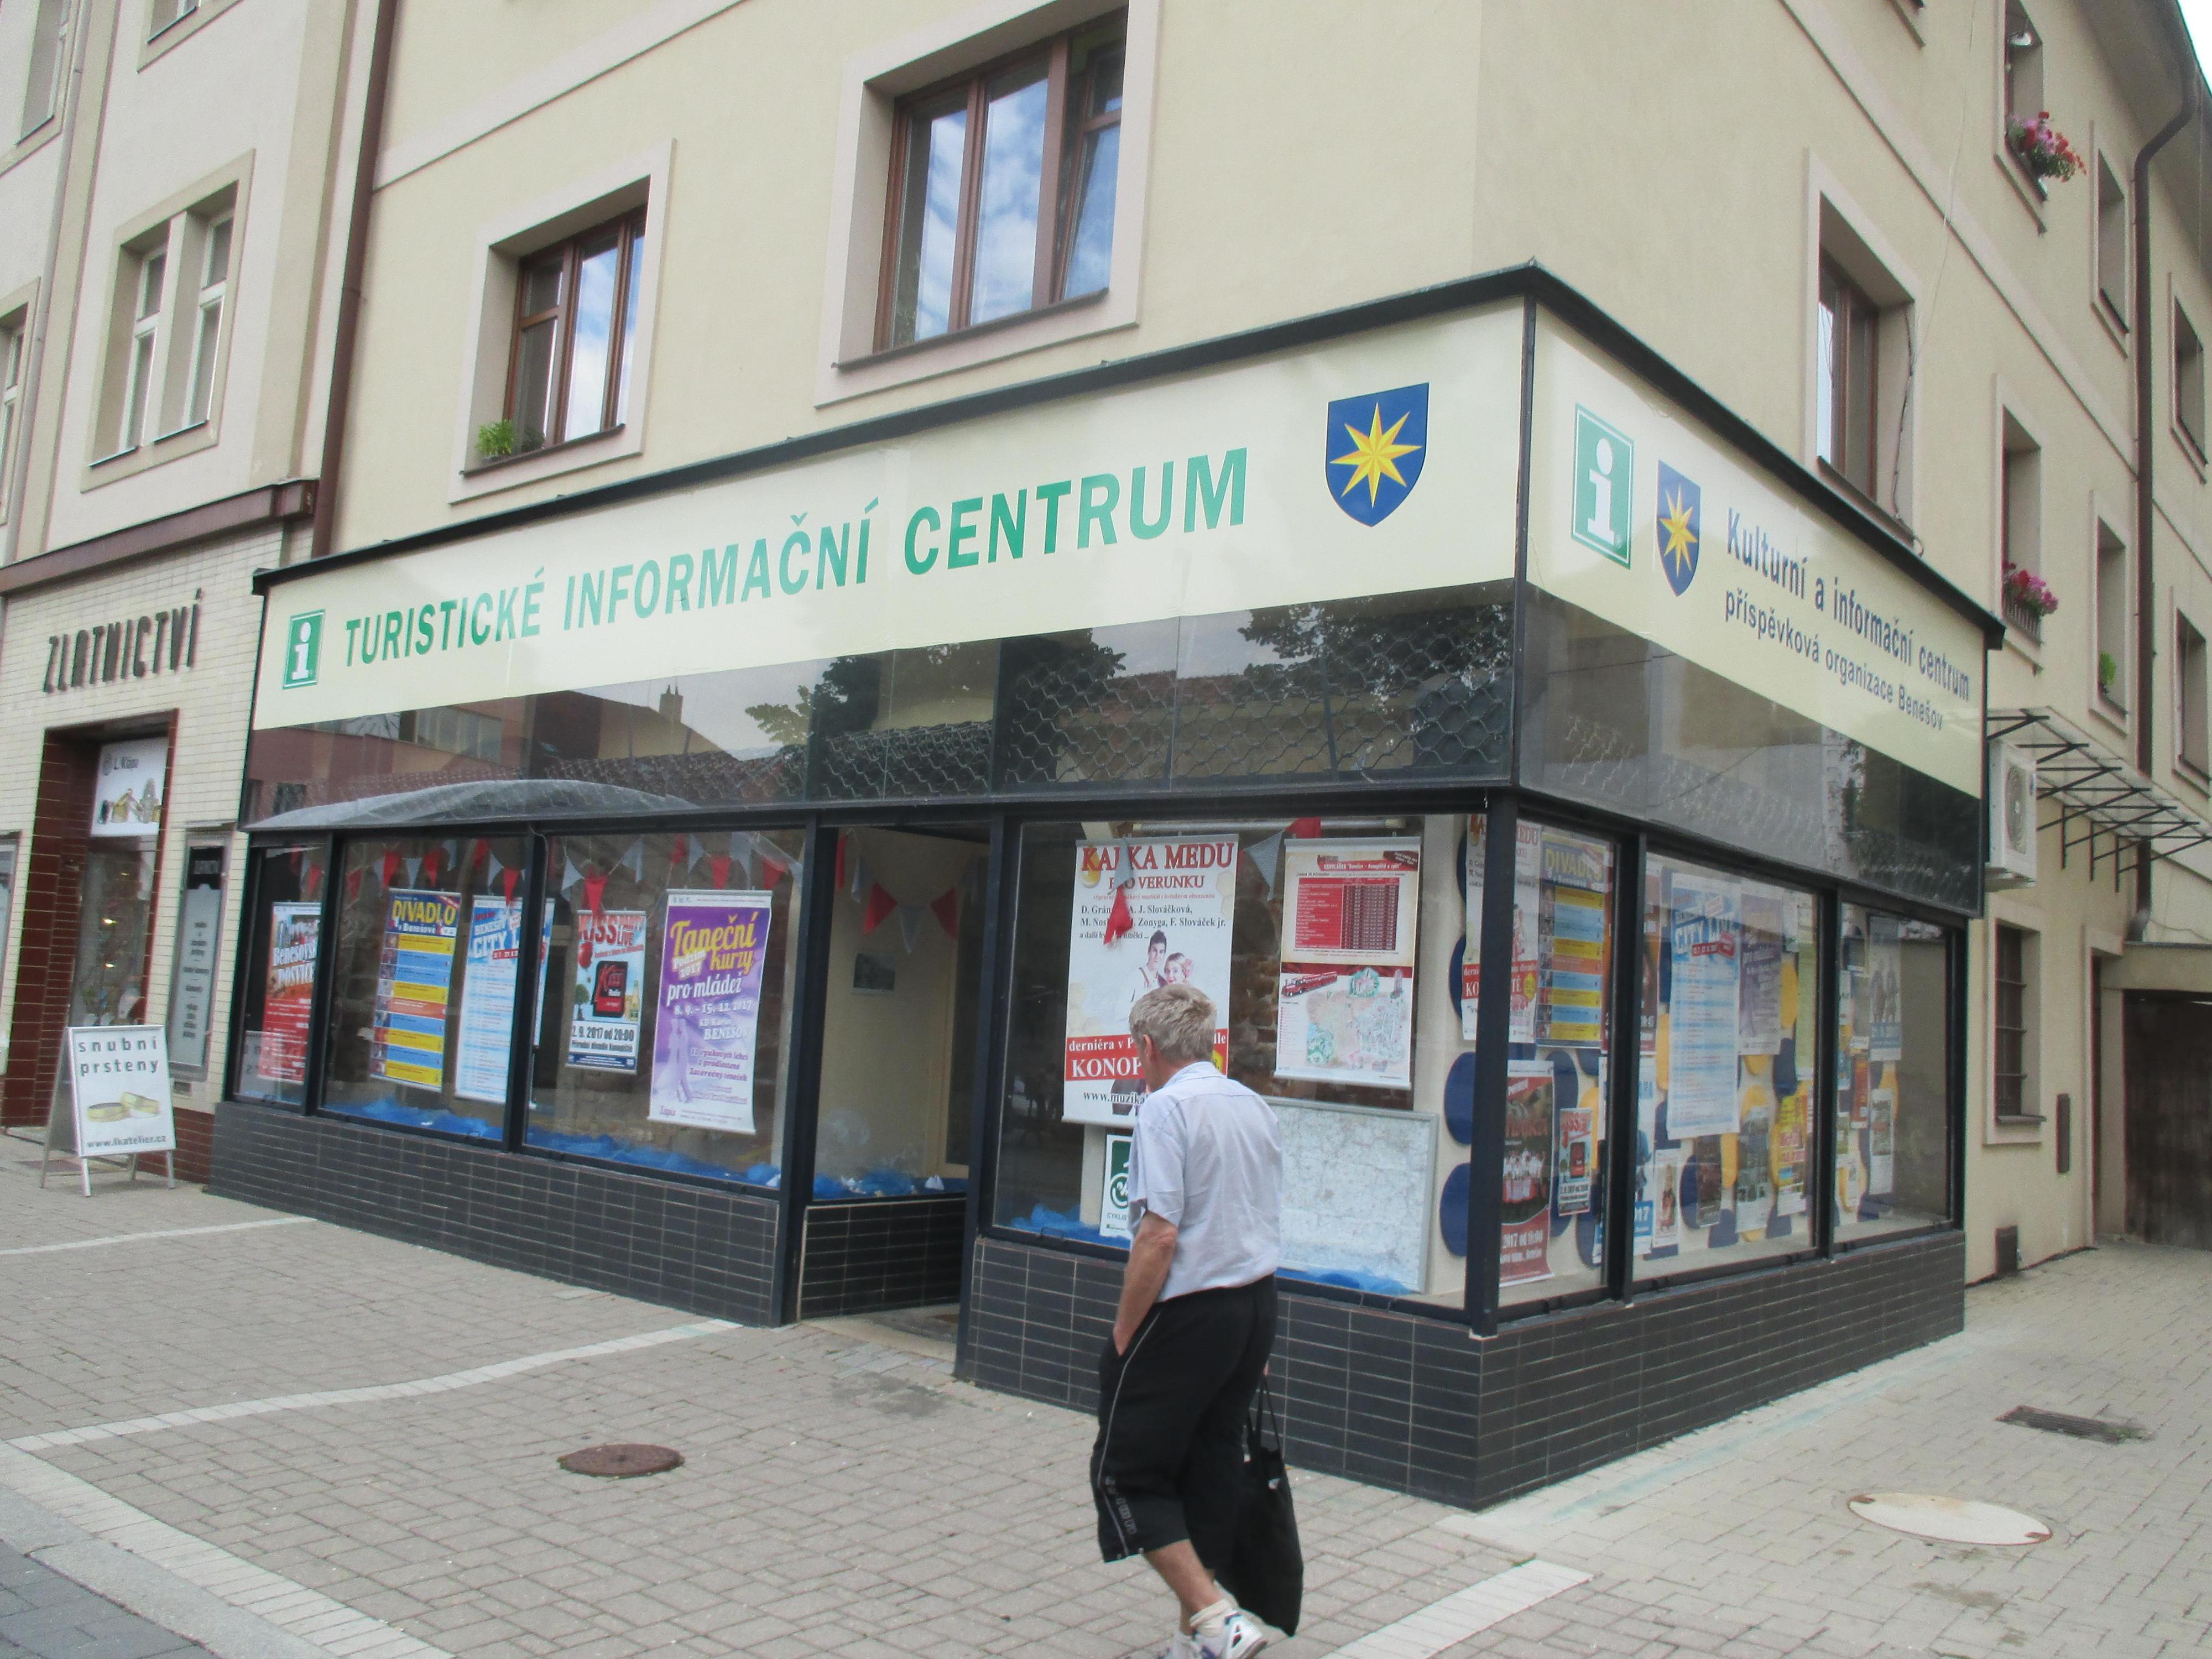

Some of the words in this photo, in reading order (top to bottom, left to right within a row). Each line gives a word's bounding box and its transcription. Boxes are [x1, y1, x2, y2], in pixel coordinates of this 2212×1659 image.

[346, 567, 545, 667] TURISTICKÉ
[563, 497, 879, 630] INFORMAČNÍ
[904, 447, 1248, 575] CENTRUM
[1727, 507, 1808, 599] Kulturní
[1814, 577, 1824, 611] a
[1833, 577, 1914, 666] informační
[1918, 645, 1970, 702] centrum
[1725, 588, 1819, 664] příspěvková
[1825, 649, 1893, 703] organizace
[1898, 684, 1944, 730] Benešov
[1164, 842, 1234, 869] MEDU
[1138, 875, 1205, 889] VERUNKU
[392, 900, 456, 925] DIVADLO
[1082, 905, 1089, 914] D.
[1139, 905, 1145, 914] J.
[1147, 904, 1192, 915] Slováčková,
[1081, 918, 1091, 926] M.
[1180, 917, 1215, 926] Slováček
[670, 911, 760, 957] Taneční
[709, 948, 755, 975] kurzy
[666, 983, 691, 1006] pro
[693, 971, 743, 998] mládež
[587, 1026, 603, 1039] 2017
[78, 1036, 158, 1053] snubní
[1069, 1040, 1114, 1051] derniéra
[80, 1058, 159, 1077] prsteny
[1072, 1057, 1142, 1078] KONOP
